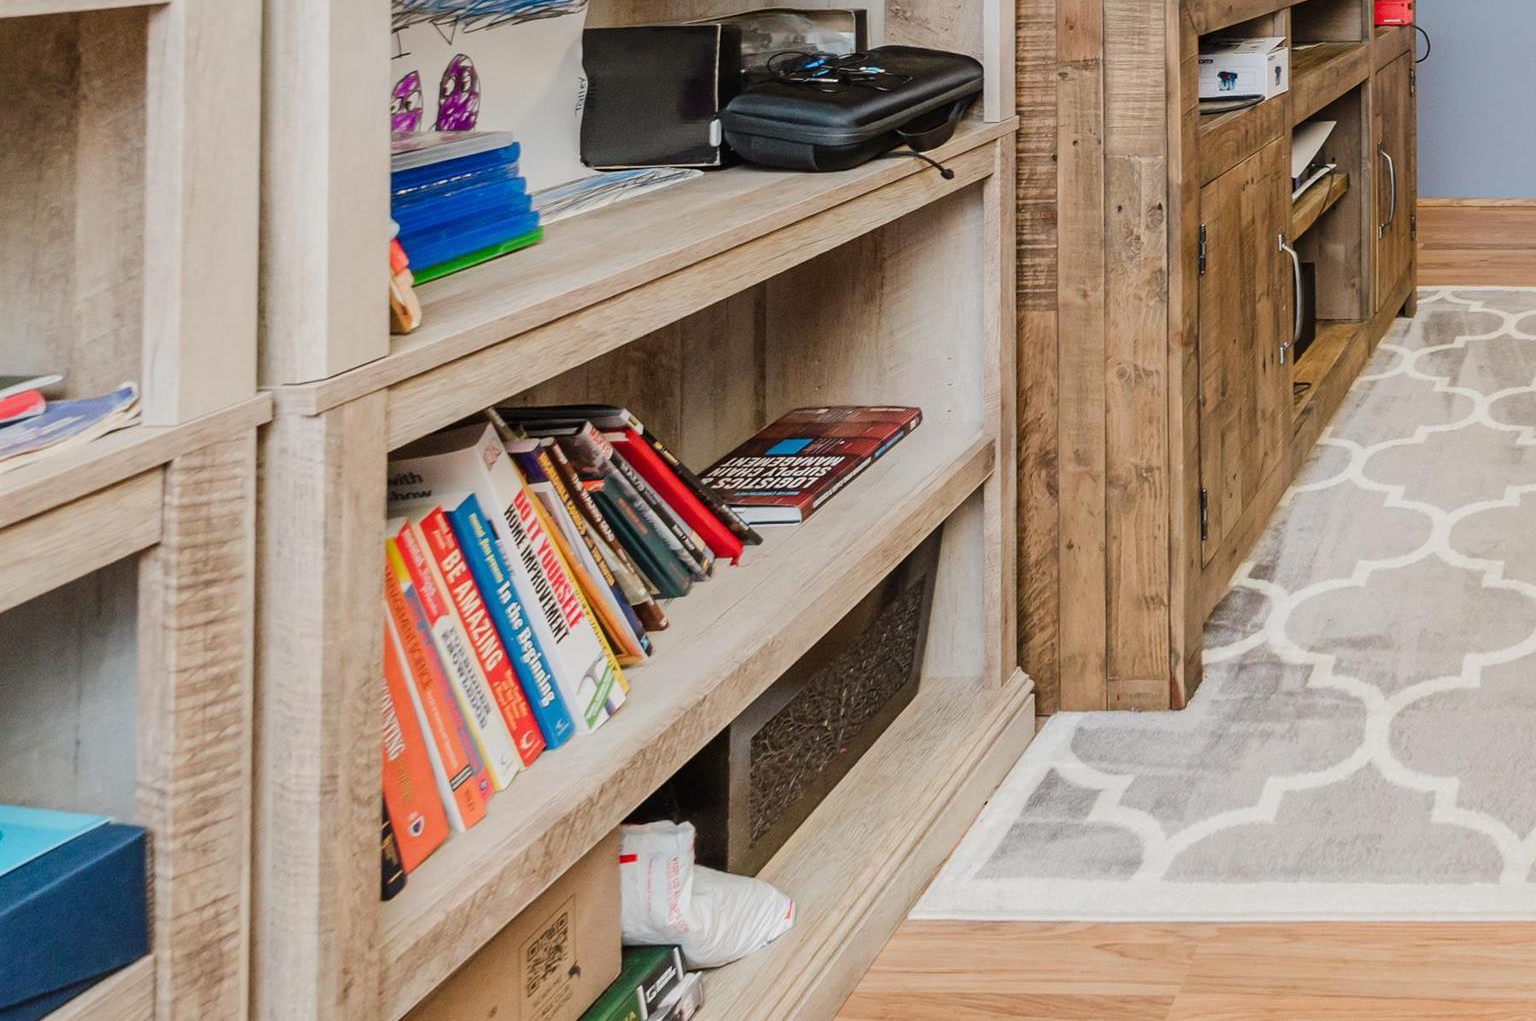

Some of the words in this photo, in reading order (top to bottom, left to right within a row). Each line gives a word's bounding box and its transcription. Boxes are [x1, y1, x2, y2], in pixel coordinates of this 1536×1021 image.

[707, 467, 764, 478] CHAIN
[721, 456, 845, 467] MANAGEMENT
[765, 467, 832, 477] SUPPLY
[712, 478, 819, 489] LOGISTICS
[441, 551, 466, 583] BE
[512, 487, 532, 522] DO
[526, 517, 544, 543] IT
[536, 538, 585, 628] YOURSELF
[503, 503, 528, 550] HOME
[520, 545, 570, 645] IMPROVEMENT
[453, 580, 503, 672] AMAZING
[498, 580, 512, 605] In
[505, 602, 524, 631] the
[518, 626, 556, 708] Beginning
